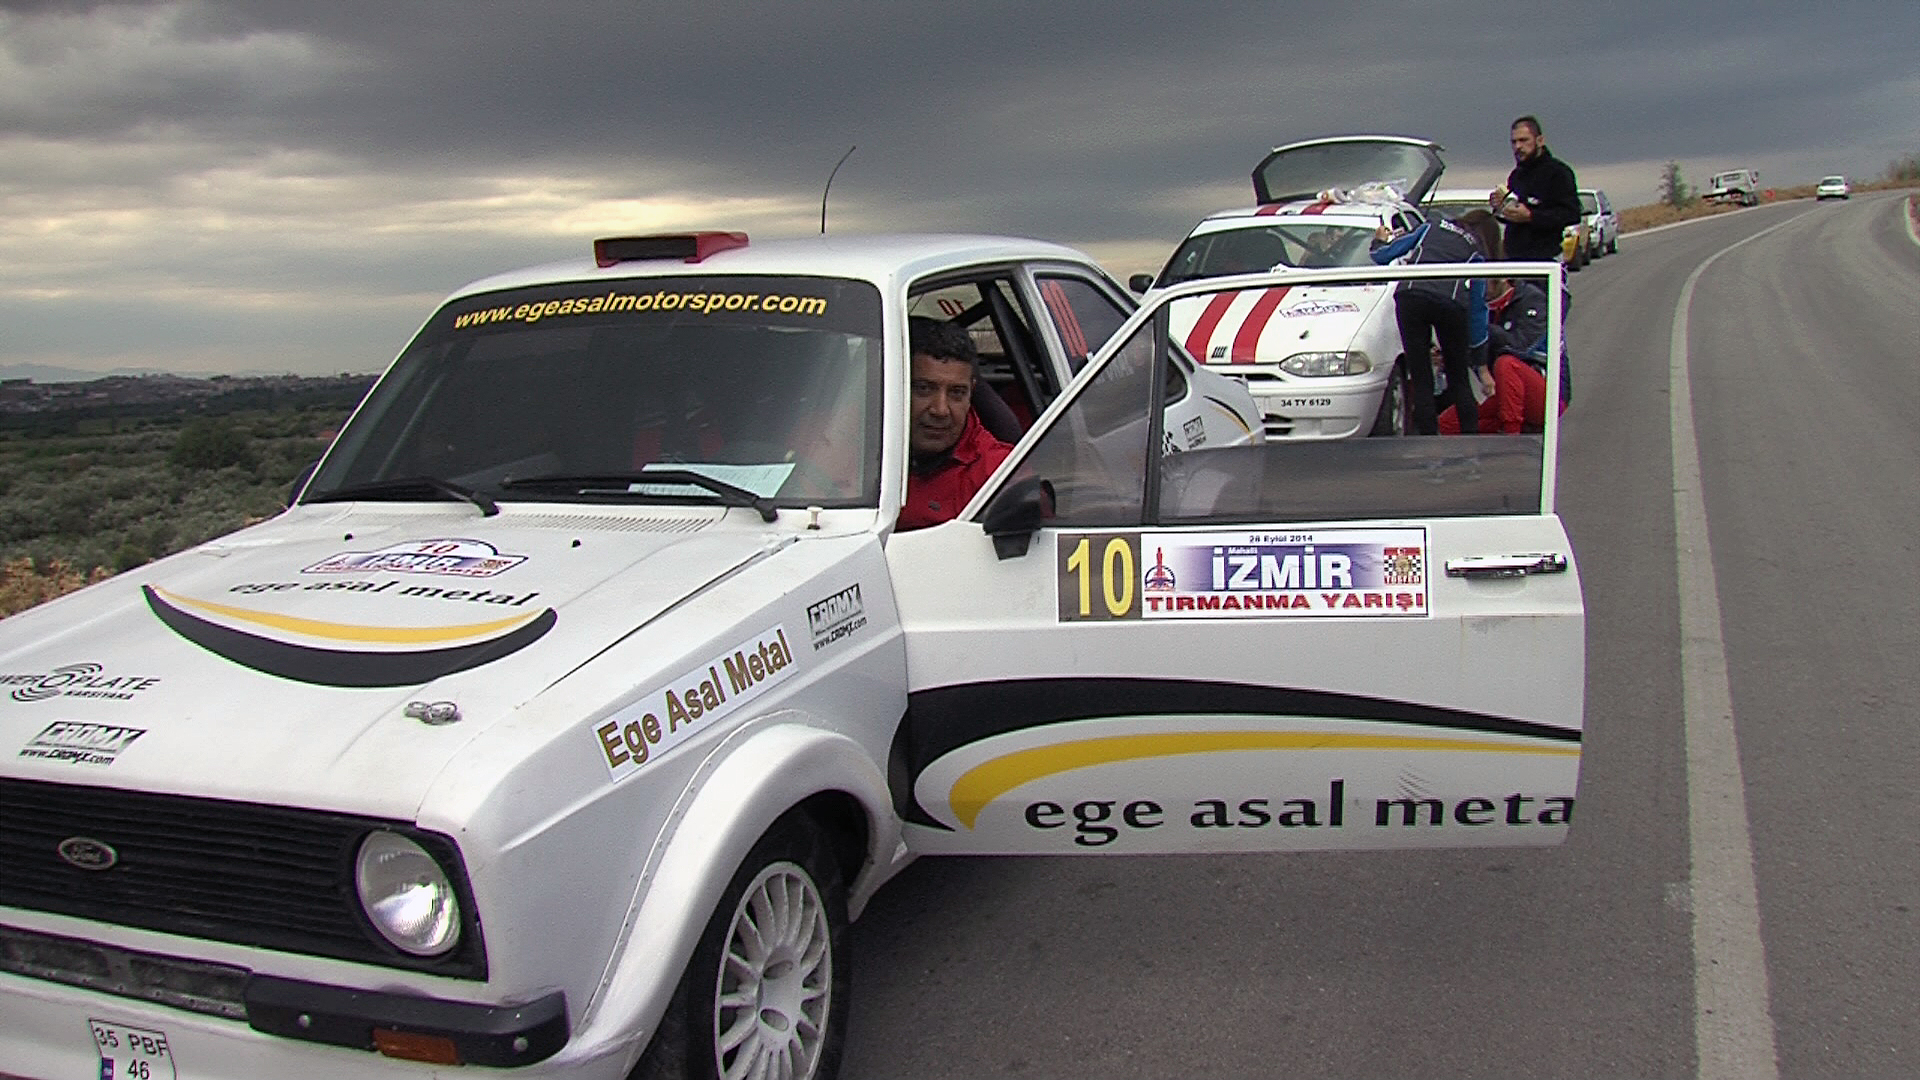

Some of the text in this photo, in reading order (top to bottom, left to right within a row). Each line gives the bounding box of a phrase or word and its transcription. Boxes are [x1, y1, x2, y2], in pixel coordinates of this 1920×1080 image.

[453, 291, 828, 330] www.egeasalmotorspor.com
[1280, 398, 1331, 407] 34 TY 6129
[417, 543, 460, 554] 10
[1249, 534, 1313, 545] 28 Eylül 2014
[1067, 537, 1134, 616] 10
[1212, 544, 1353, 591] İZMİR
[229, 580, 541, 607] ege asal metal
[1145, 592, 1424, 611] TIRMANMA YARIŞI
[597, 628, 793, 769] Ege Asal Metal
[1024, 799, 1164, 847] ege
[1190, 779, 1345, 828] asal
[95, 1027, 167, 1056] 35 PBF
[128, 1059, 150, 1080] 46
